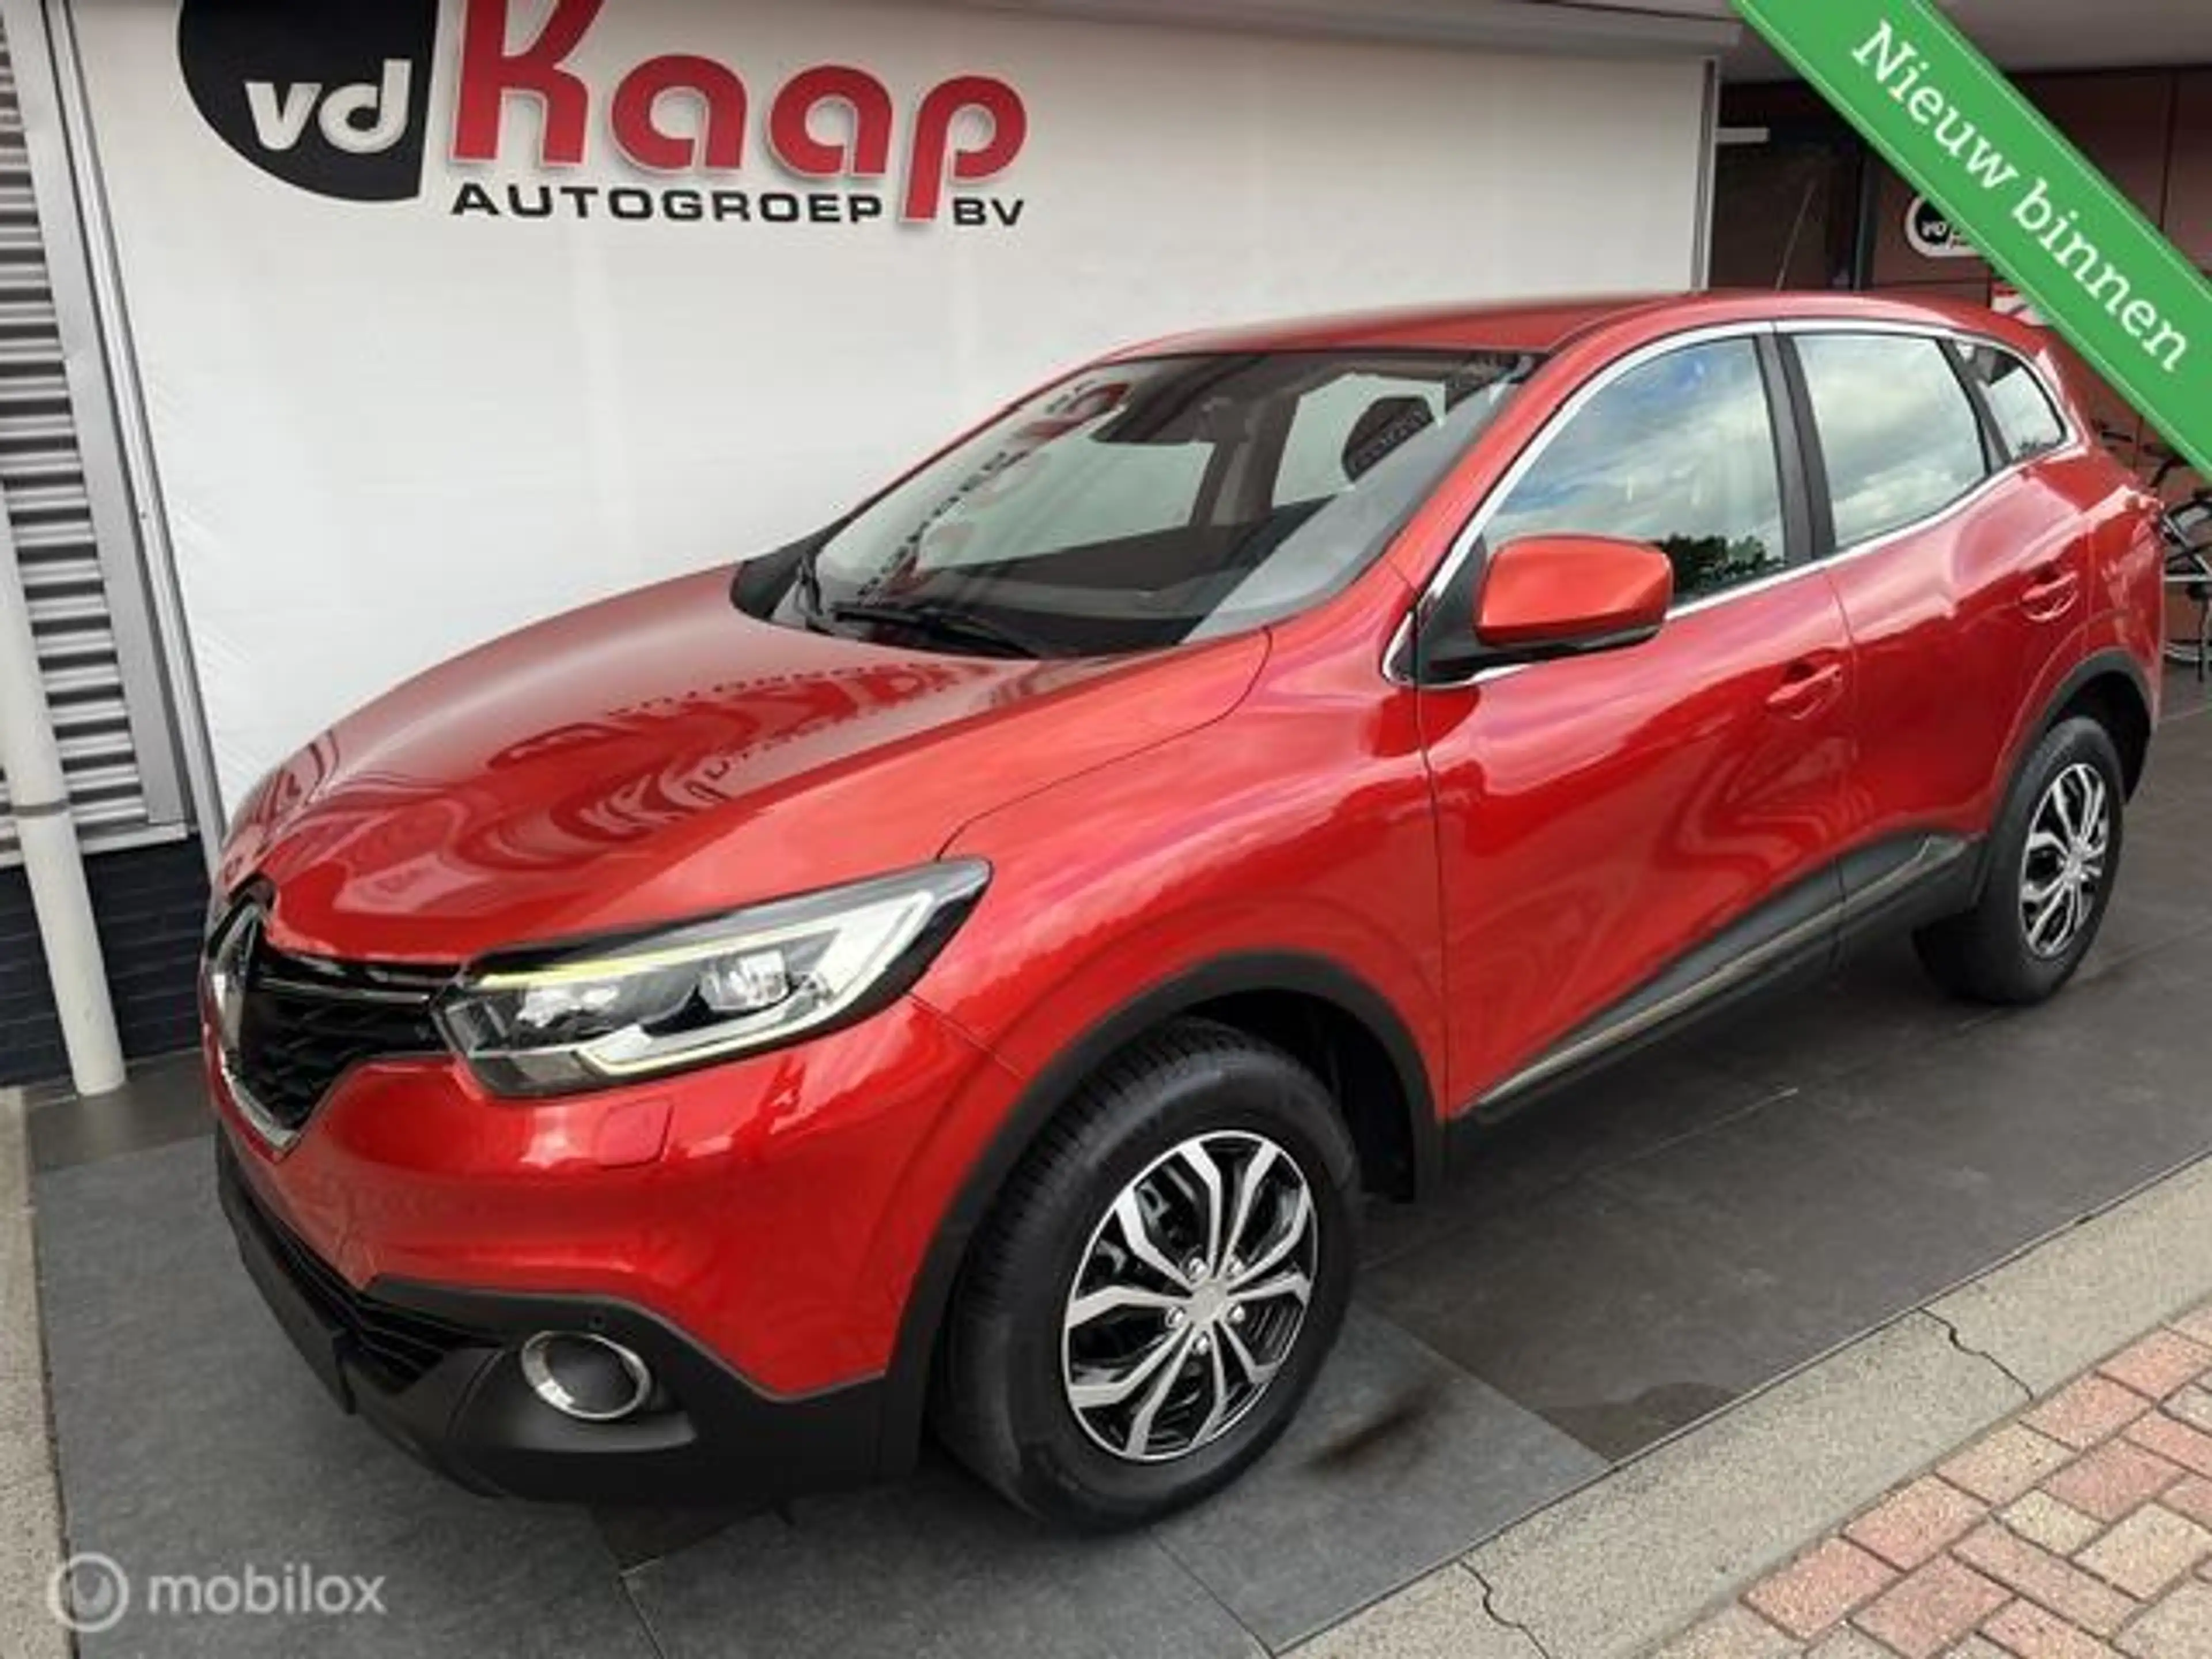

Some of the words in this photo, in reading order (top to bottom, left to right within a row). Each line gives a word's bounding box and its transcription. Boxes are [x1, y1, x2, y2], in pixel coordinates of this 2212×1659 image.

[245, 58, 411, 156] vd
[452, 0, 1028, 221] Kaap
[451, 183, 884, 225] AUTOGROEP
[953, 198, 1024, 226] BV
